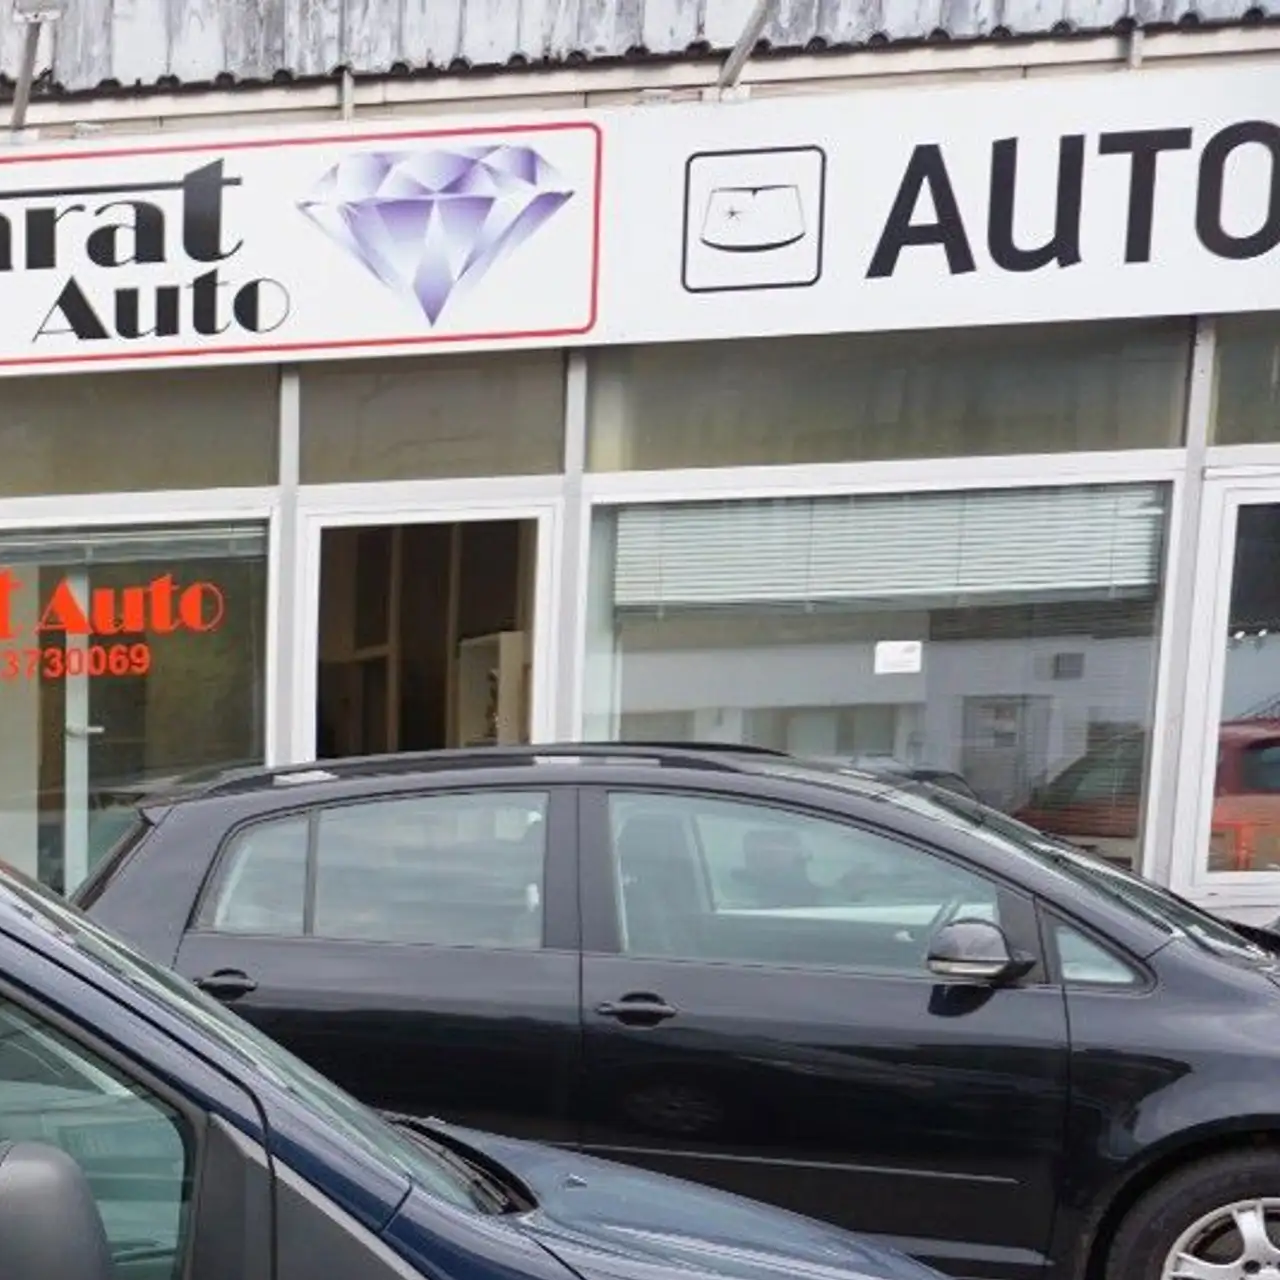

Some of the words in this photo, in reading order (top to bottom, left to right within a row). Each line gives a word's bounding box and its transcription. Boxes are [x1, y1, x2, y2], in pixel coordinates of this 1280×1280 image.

[865, 119, 1280, 279] AUTO
[32, 269, 291, 343] Auto
[36, 573, 224, 635] Auto
